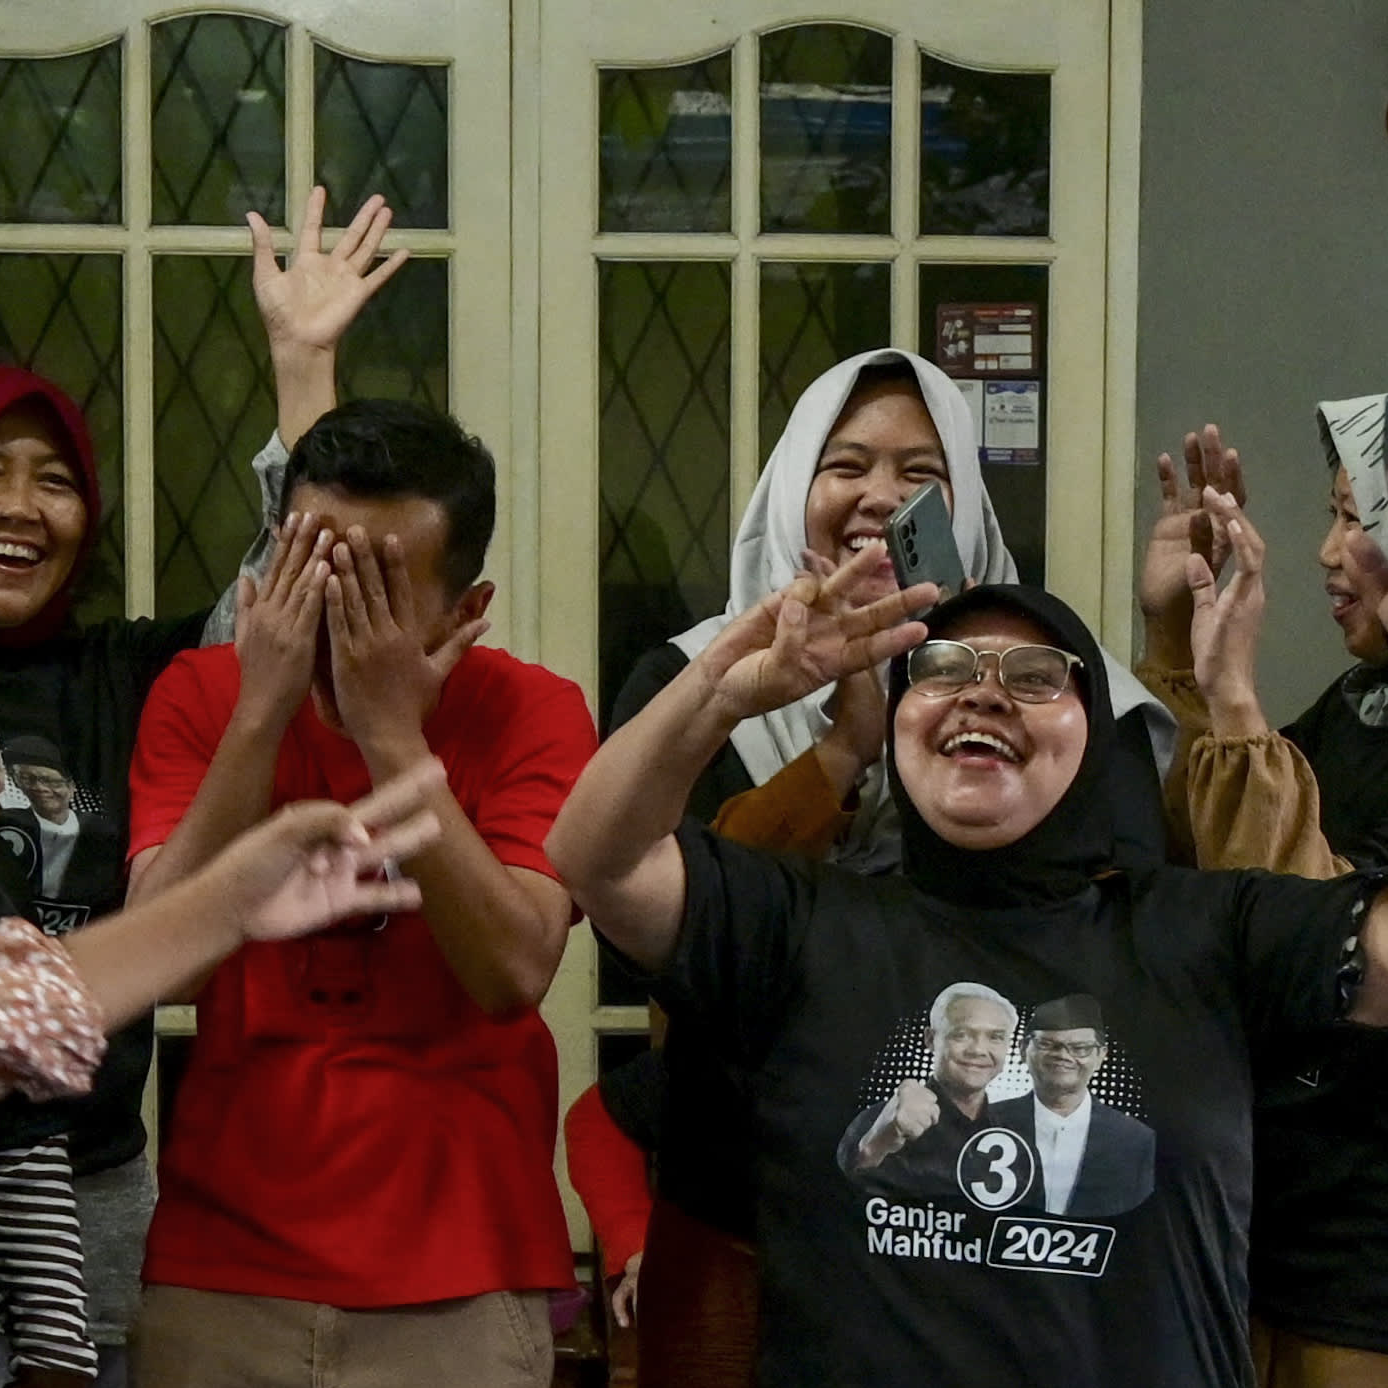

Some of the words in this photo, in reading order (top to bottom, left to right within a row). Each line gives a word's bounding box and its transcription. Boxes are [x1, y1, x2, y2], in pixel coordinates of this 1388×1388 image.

[36, 907, 78, 935] 24
[971, 1132, 1019, 1207] 3
[865, 1198, 966, 1235] Ganjar
[868, 1226, 981, 1263] Mahfud
[1001, 1226, 1098, 1266] 2024
